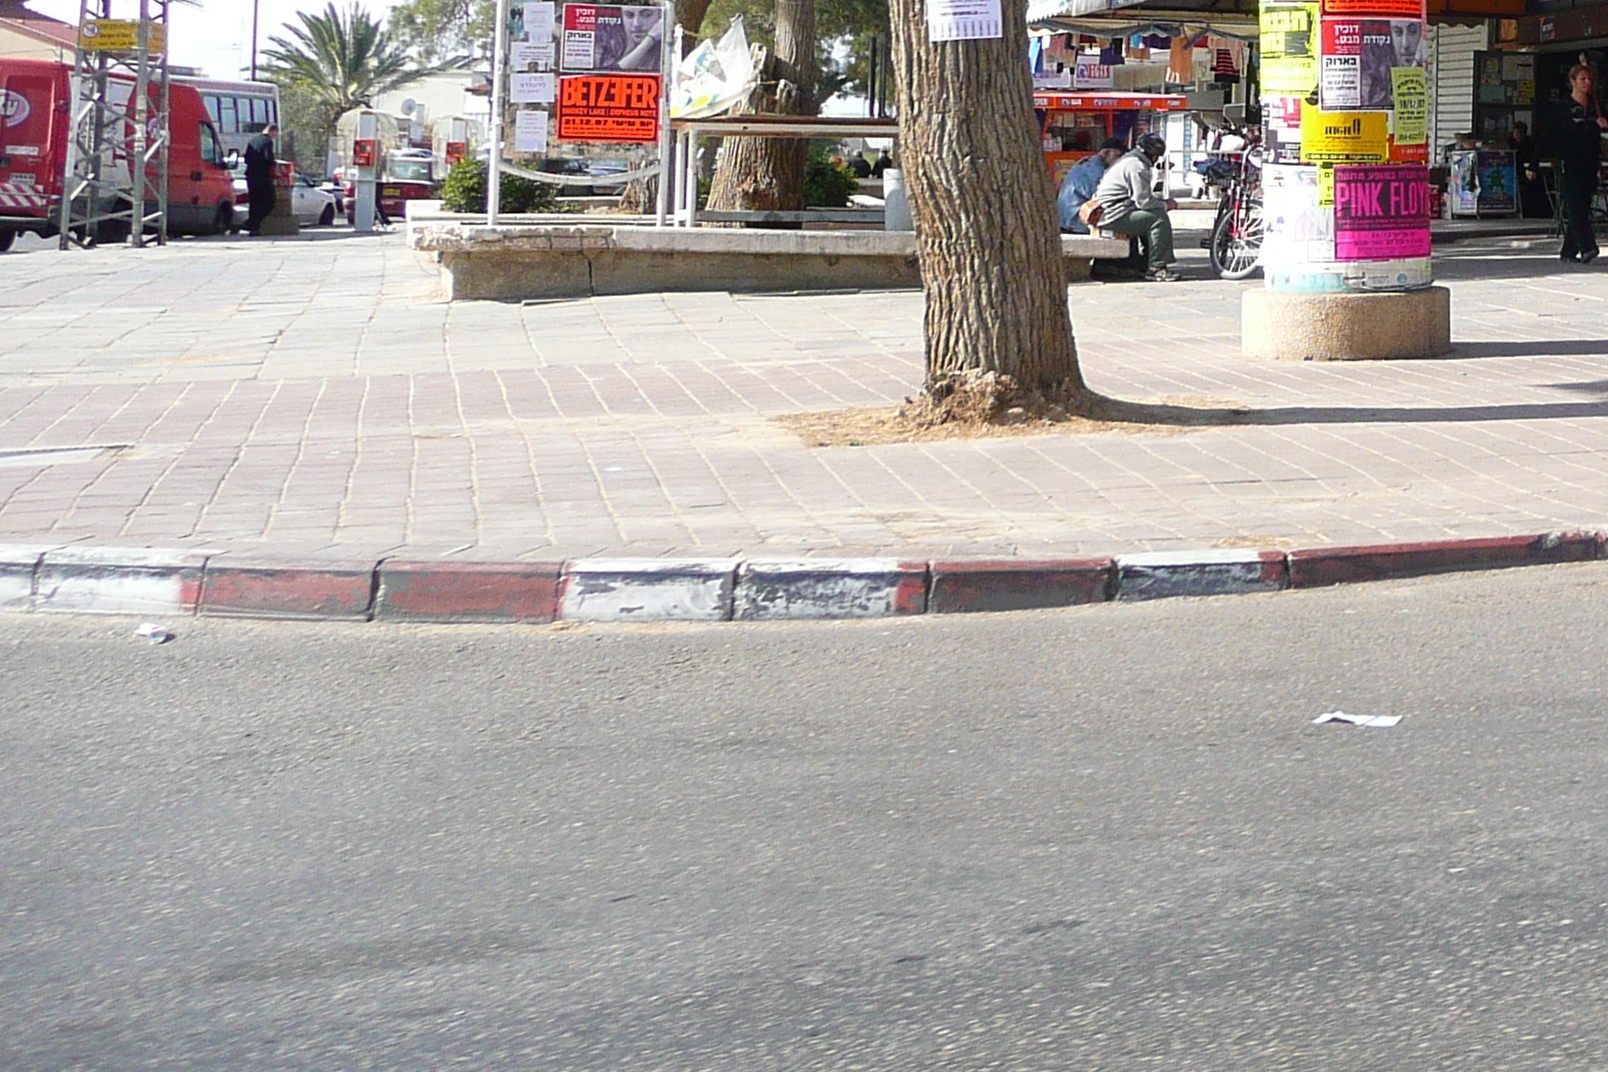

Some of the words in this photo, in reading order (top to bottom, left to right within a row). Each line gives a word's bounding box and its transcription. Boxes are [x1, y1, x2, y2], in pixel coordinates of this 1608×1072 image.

[1363, 36, 1391, 46] נקודת
[1325, 57, 1357, 67] בארוק
[562, 77, 657, 108] BETZEFER
[564, 118, 608, 126] 21.12.07
[1336, 181, 1384, 218] PINK
